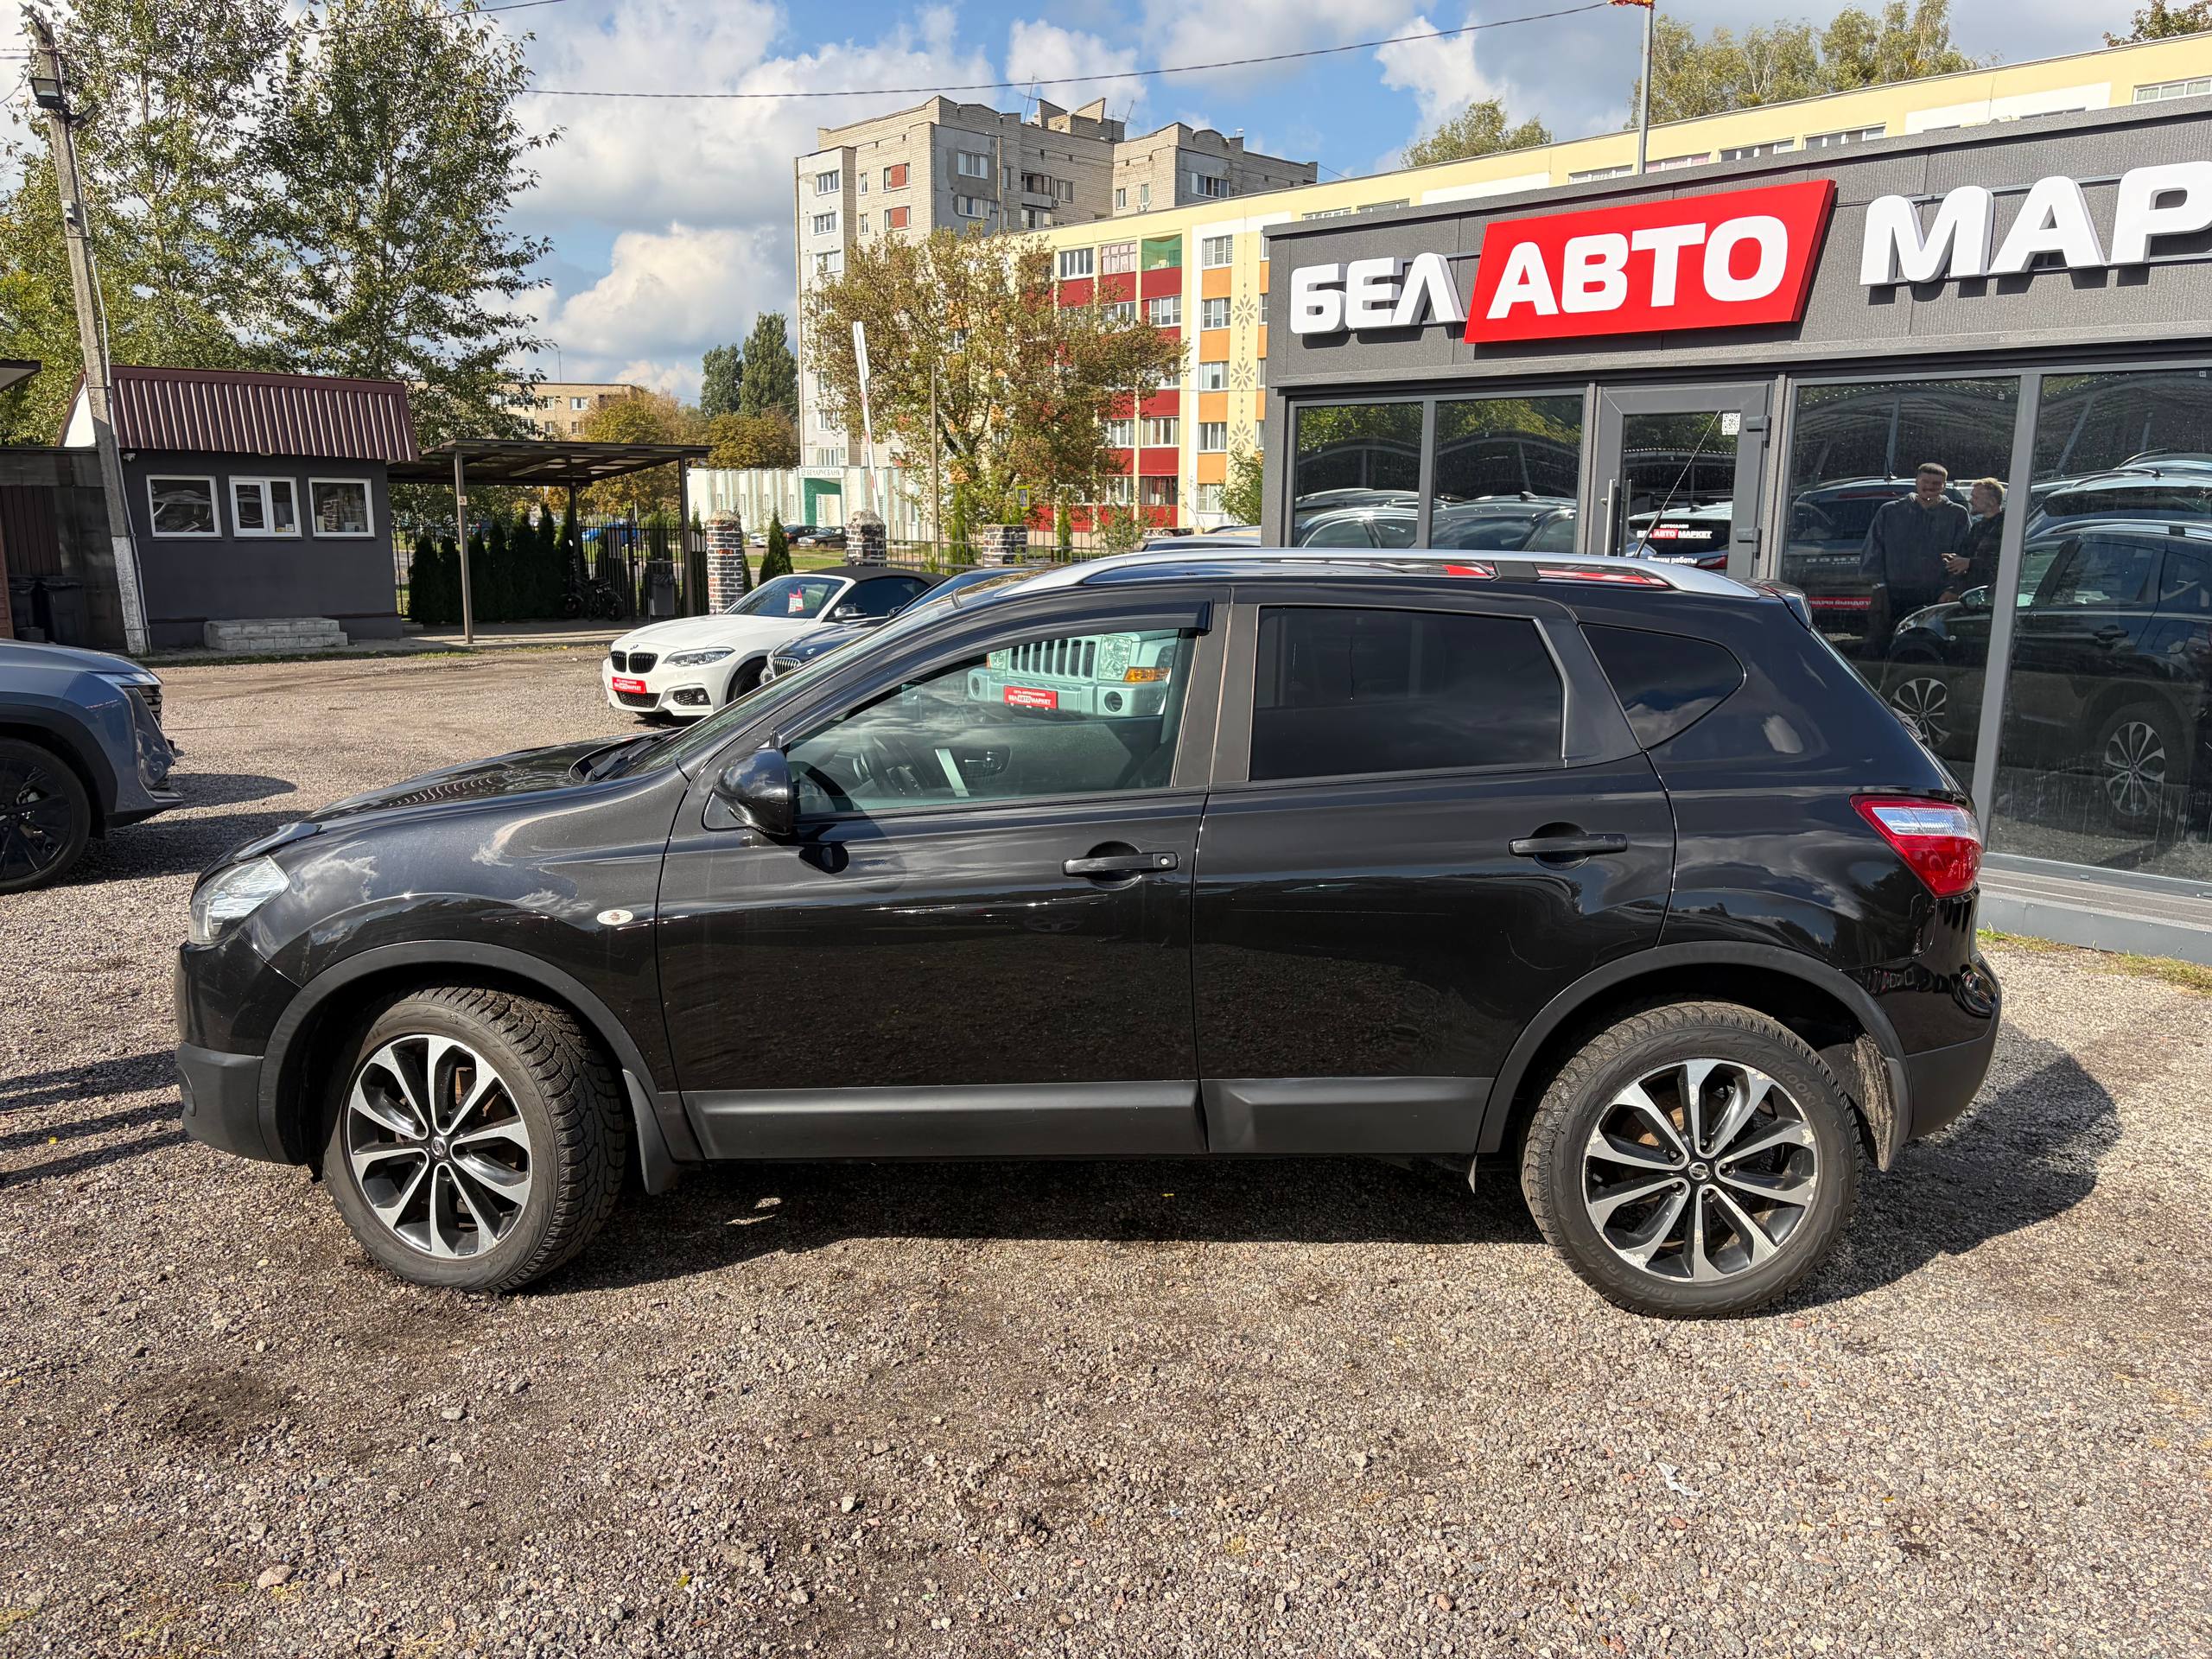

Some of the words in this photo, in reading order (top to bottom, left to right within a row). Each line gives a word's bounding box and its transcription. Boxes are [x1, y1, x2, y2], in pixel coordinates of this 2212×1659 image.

[1291, 252, 1467, 335] БЕЛ
[1486, 215, 1789, 320] АВТО
[1859, 161, 2212, 286] МАР
[1677, 531, 1713, 539] МАРКЕТ
